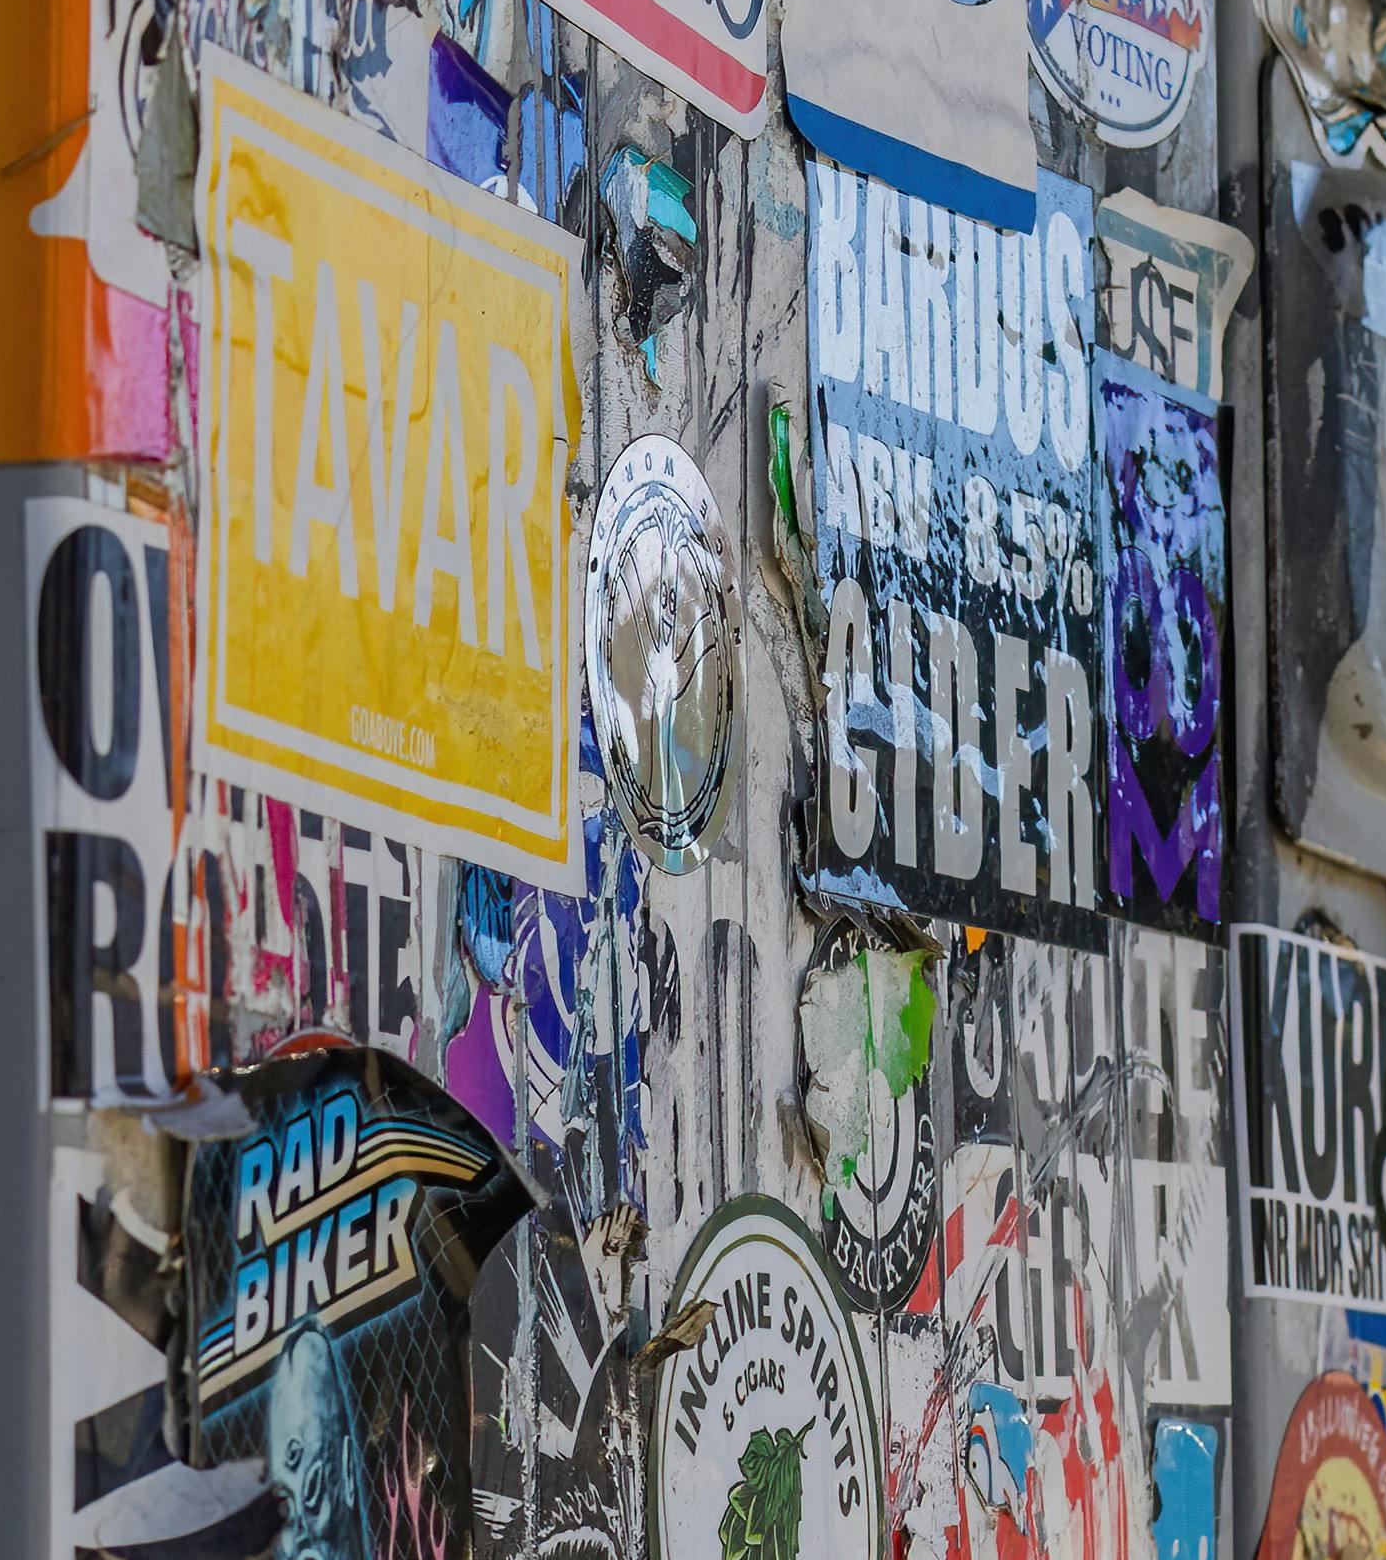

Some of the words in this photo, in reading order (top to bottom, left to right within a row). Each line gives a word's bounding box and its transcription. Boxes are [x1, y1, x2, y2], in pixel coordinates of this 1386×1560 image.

[1068, 13, 1176, 102] VOTING
[816, 162, 1090, 474] BARDOS
[350, 703, 437, 769] GOABOVE.COM
[826, 576, 1095, 913] CIDER
[237, 1088, 360, 1242] RAD
[233, 1183, 417, 1352] BIKER
[673, 1271, 772, 1457] INCLINE
[779, 1300, 861, 1519] SPIRITS
[734, 1365, 788, 1414] CIGARS
